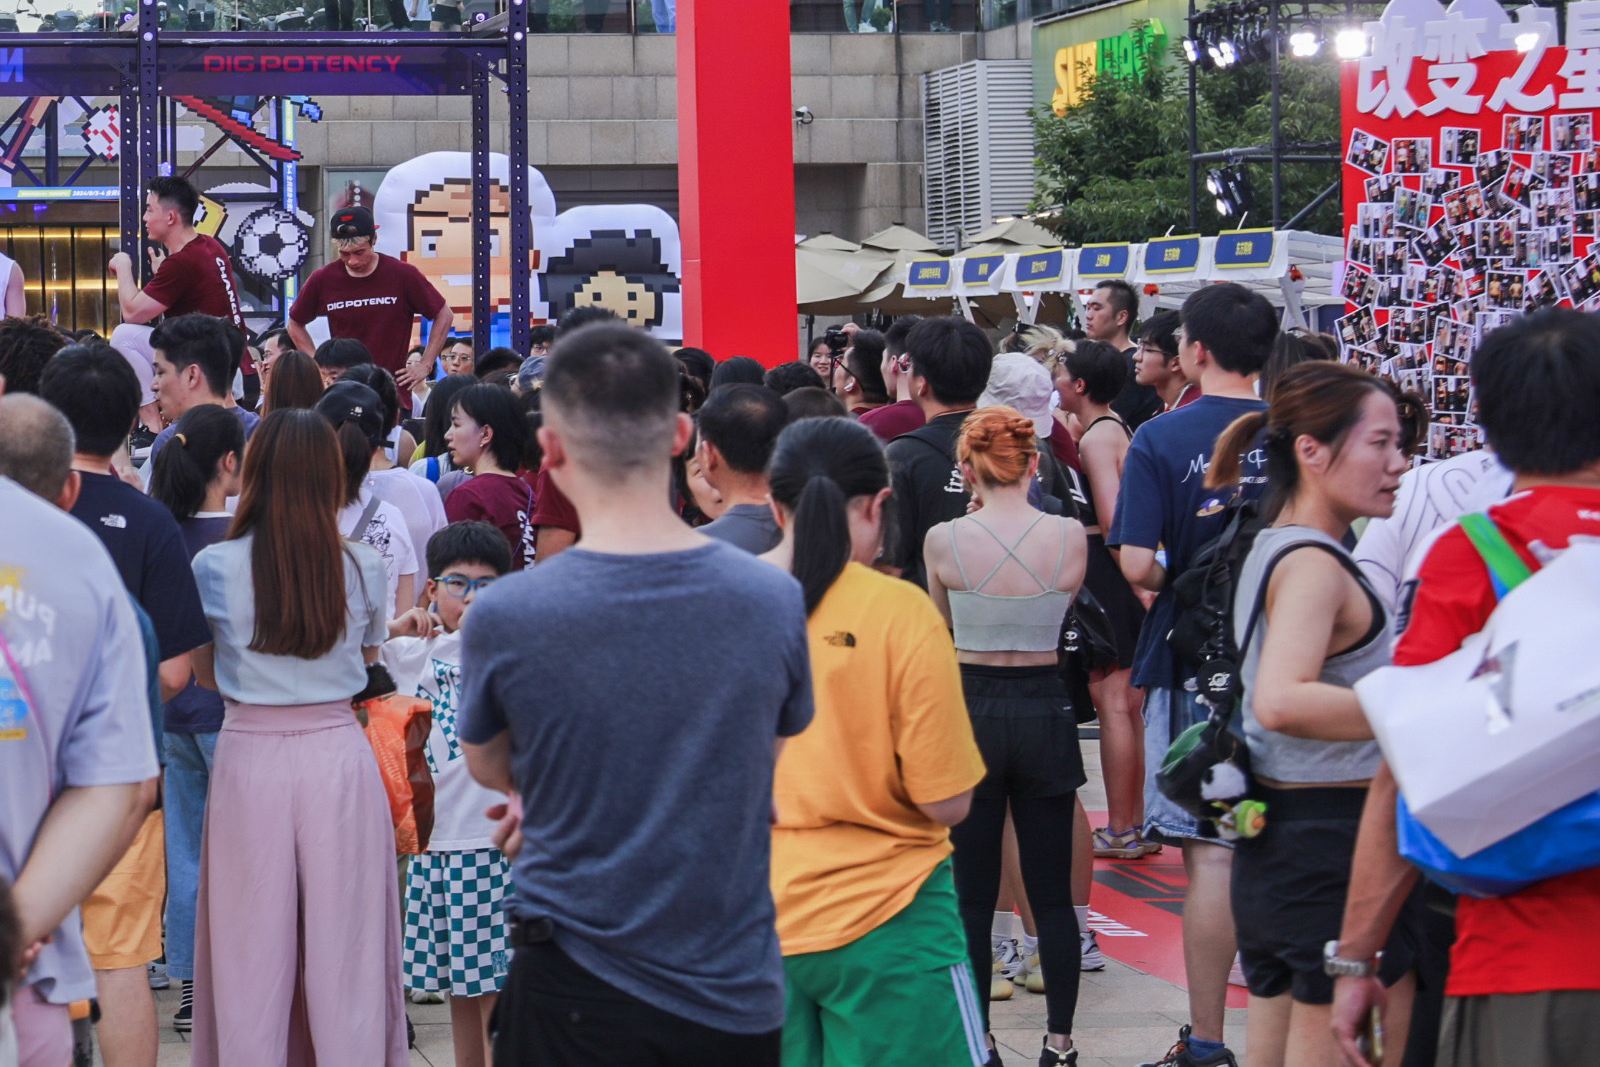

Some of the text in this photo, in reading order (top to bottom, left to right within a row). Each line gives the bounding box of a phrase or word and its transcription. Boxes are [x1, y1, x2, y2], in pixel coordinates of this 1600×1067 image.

[204, 55, 402, 72] DIG POTENCY
[326, 296, 398, 312] DIG POTENCY
